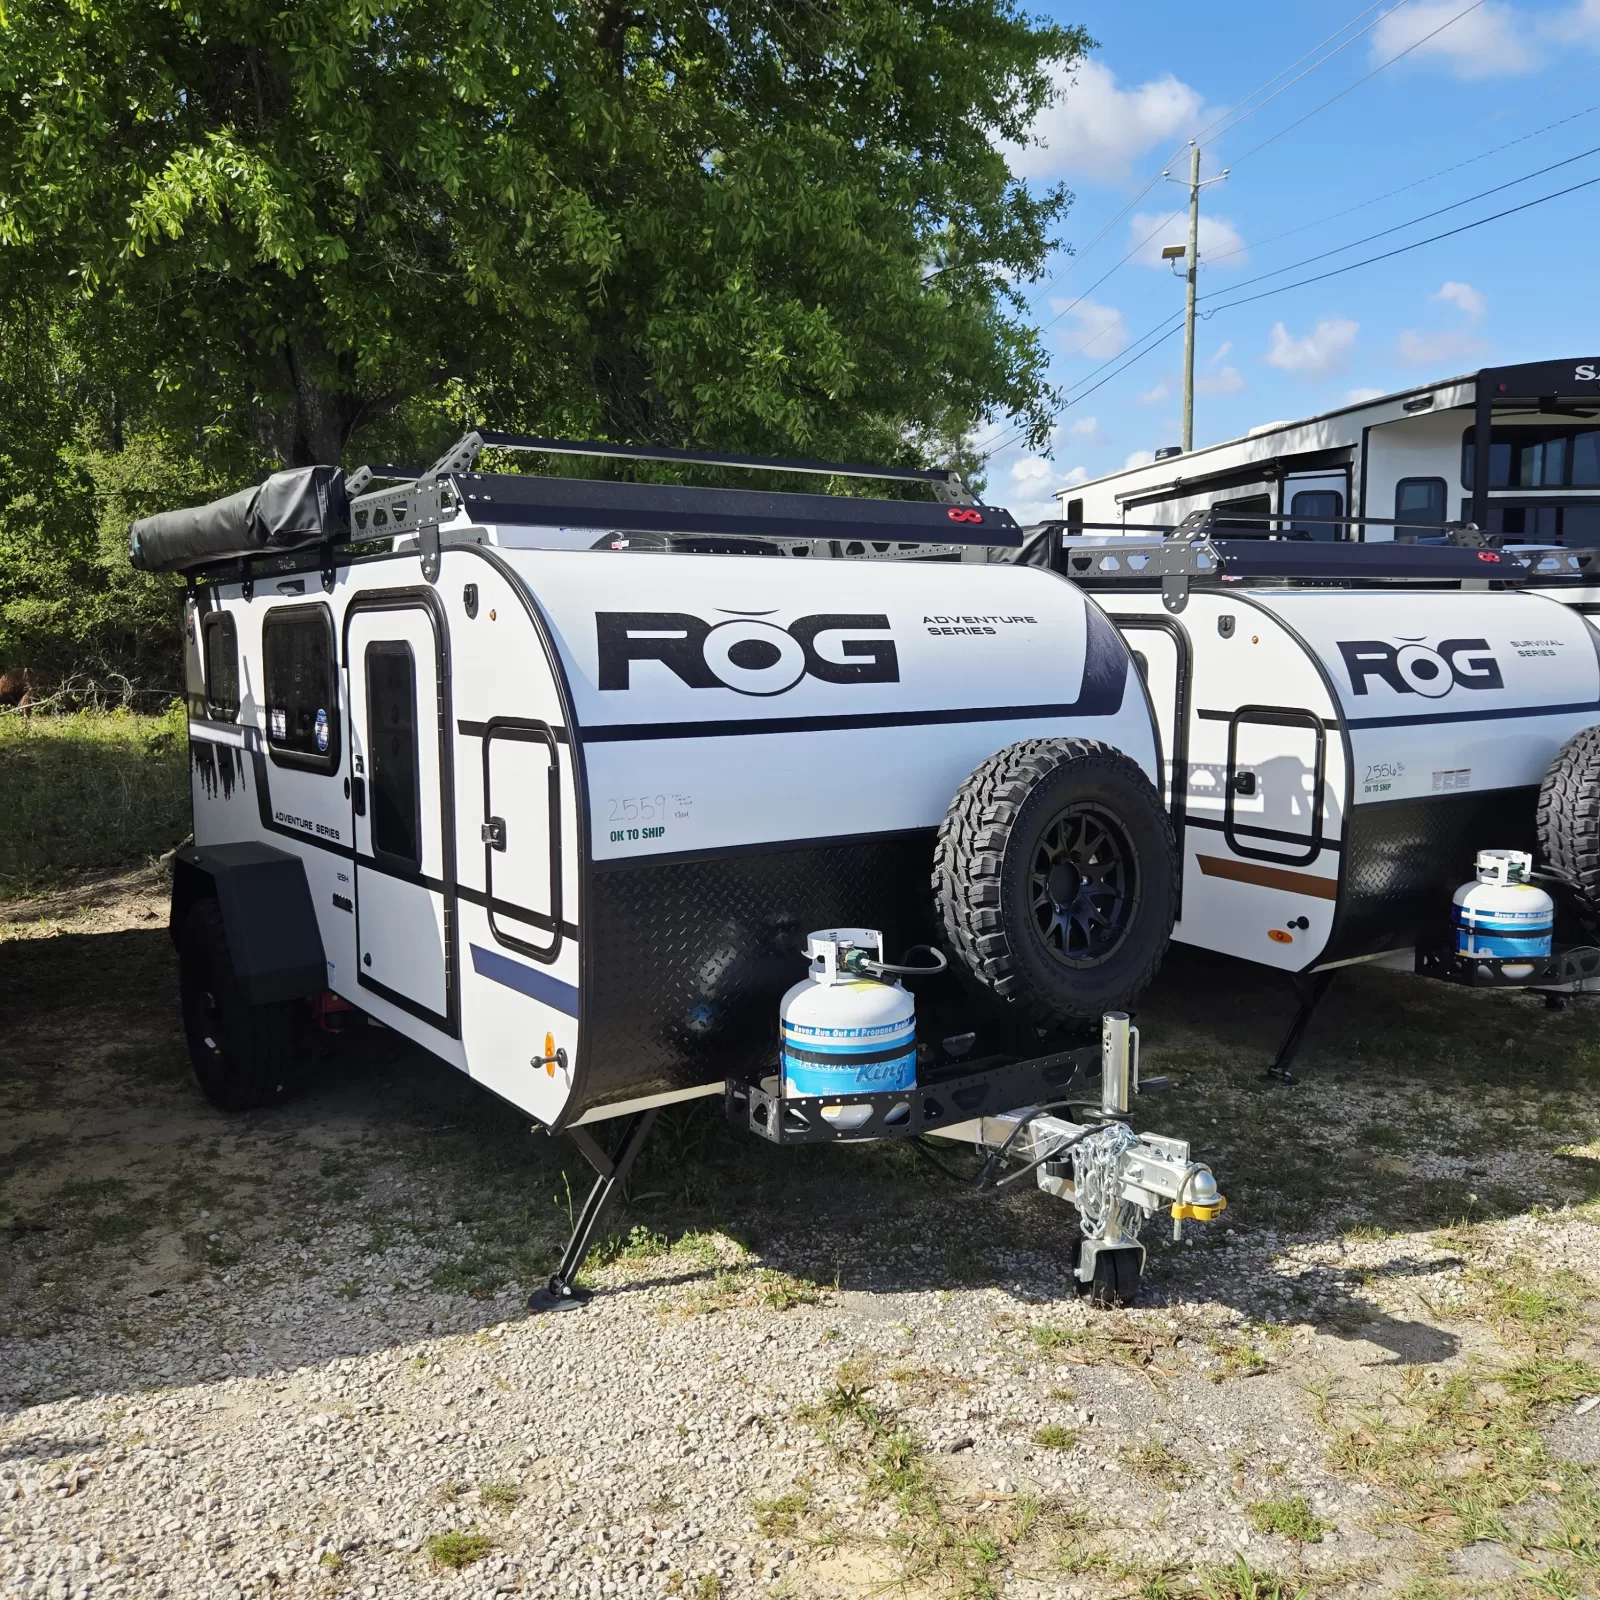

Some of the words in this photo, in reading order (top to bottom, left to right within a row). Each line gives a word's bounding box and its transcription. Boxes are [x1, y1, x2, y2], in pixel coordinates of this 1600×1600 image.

[1574, 364, 1600, 381] S
[922, 615, 1038, 624] ADVENTURE
[927, 626, 997, 636] SERIES
[1509, 640, 1565, 648] SURVIVAL
[1516, 649, 1557, 657] SERIES
[1364, 785, 1372, 793] OK
[1373, 784, 1379, 792] TO
[1379, 783, 1392, 792] SHIP
[607, 794, 667, 822] 2559
[275, 811, 313, 831] ADVENTURE
[315, 823, 341, 840] SERIES
[610, 830, 625, 842] OK
[627, 828, 639, 841] TO
[642, 826, 666, 839] SHIP
[793, 1024, 814, 1035] Never
[815, 1028, 830, 1037] Run
[832, 1028, 848, 1037] Out
[849, 1028, 859, 1037] of
[861, 1026, 893, 1037] Propane
[855, 1061, 908, 1085] King
